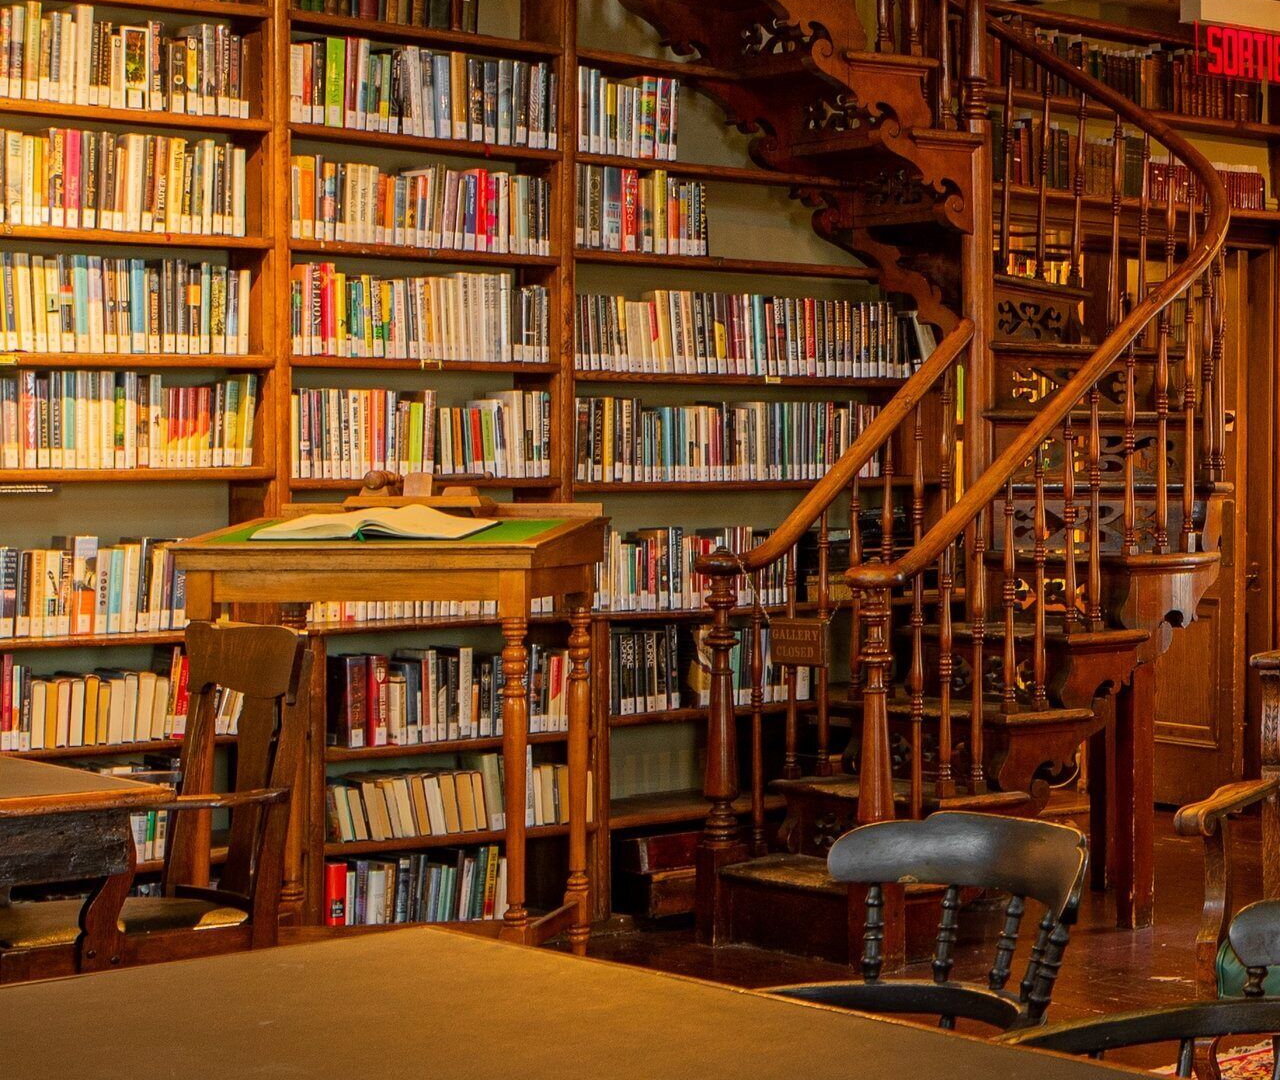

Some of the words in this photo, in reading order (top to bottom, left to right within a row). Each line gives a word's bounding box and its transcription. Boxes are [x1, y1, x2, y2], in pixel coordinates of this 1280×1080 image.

[312, 271, 322, 326] WELDON
[772, 629, 818, 642] GALLERY
[776, 646, 814, 658] CLOSED
